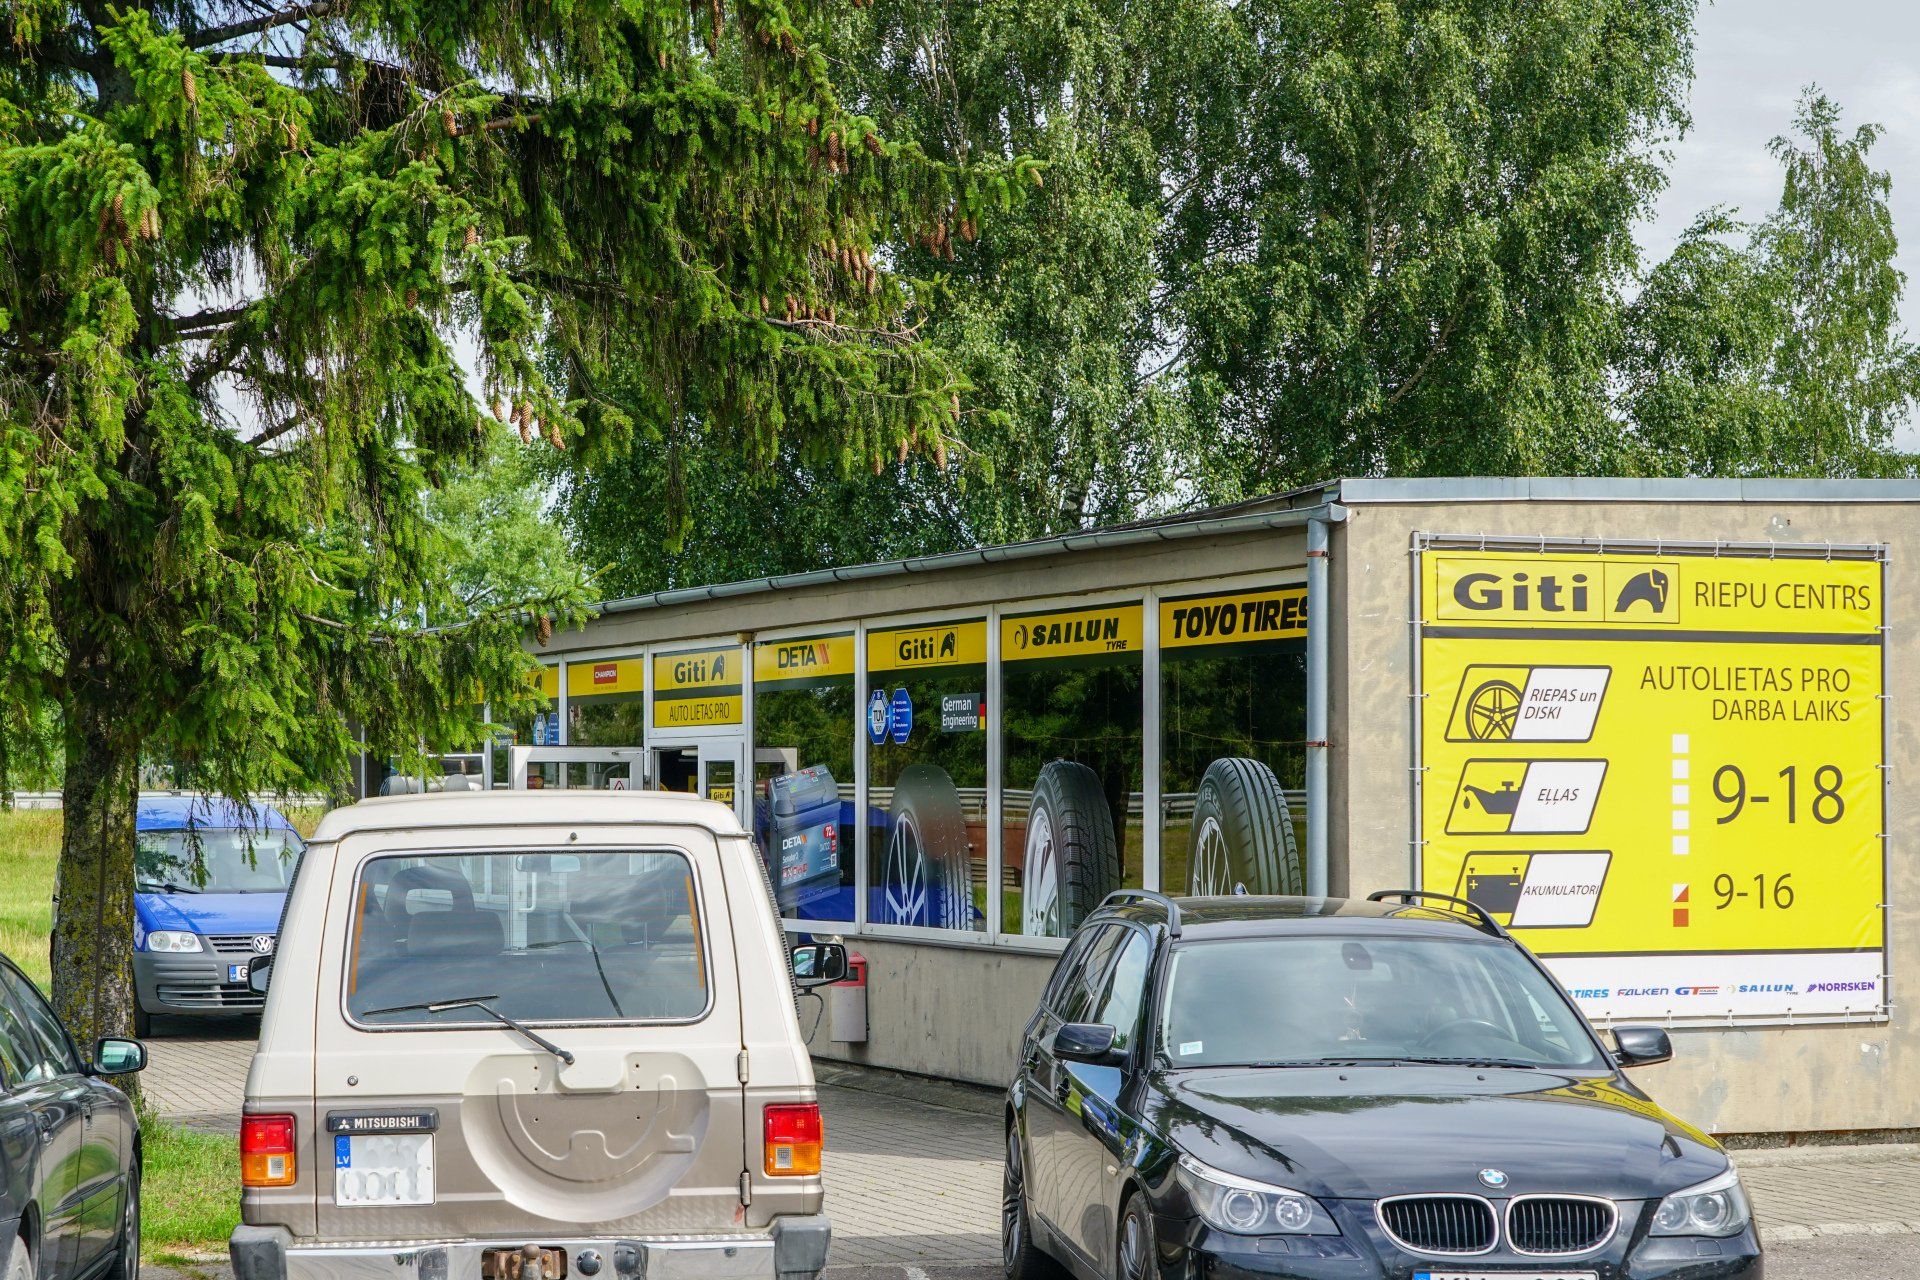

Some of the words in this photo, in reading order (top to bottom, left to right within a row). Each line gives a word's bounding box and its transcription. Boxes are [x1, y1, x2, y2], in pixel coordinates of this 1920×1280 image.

[1453, 572, 1588, 612] Giti
[1694, 581, 1766, 609] RIEPU
[1775, 582, 1871, 611] CENTRS
[1173, 603, 1238, 639] TOYO
[1031, 617, 1119, 647] SAILUN
[899, 636, 934, 661] Giti
[1106, 640, 1127, 651] TYRE
[778, 644, 817, 669] DETA
[594, 669, 617, 679] CHAMPION
[674, 659, 706, 684] Giti
[1640, 665, 1793, 692] AUTOLIETAS
[1802, 668, 1851, 692] PRO
[1529, 688, 1578, 702] RIEPAS
[1580, 692, 1597, 702] un
[670, 705, 688, 721] AUTO
[691, 703, 713, 720] LIETAS
[714, 702, 730, 719] PRO
[942, 697, 972, 712] German
[1524, 706, 1562, 719] DISKI
[1712, 699, 1786, 721] DARBA
[1793, 699, 1851, 722] LAIKS
[942, 713, 978, 729] Engineering
[1537, 787, 1579, 805] EĻĻAS
[1712, 763, 1846, 825] 9-18
[782, 835, 802, 850] DETA
[1523, 884, 1601, 896] AKUMULATORI
[1714, 872, 1795, 911] 9-16
[1573, 989, 1609, 998] TIRES
[1617, 987, 1669, 996] FALKEN
[1738, 984, 1794, 993] SAILUN
[1818, 981, 1875, 992] NORRSKEN
[354, 1116, 419, 1129] MITSUBISHI
[337, 1156, 350, 1165] LV
